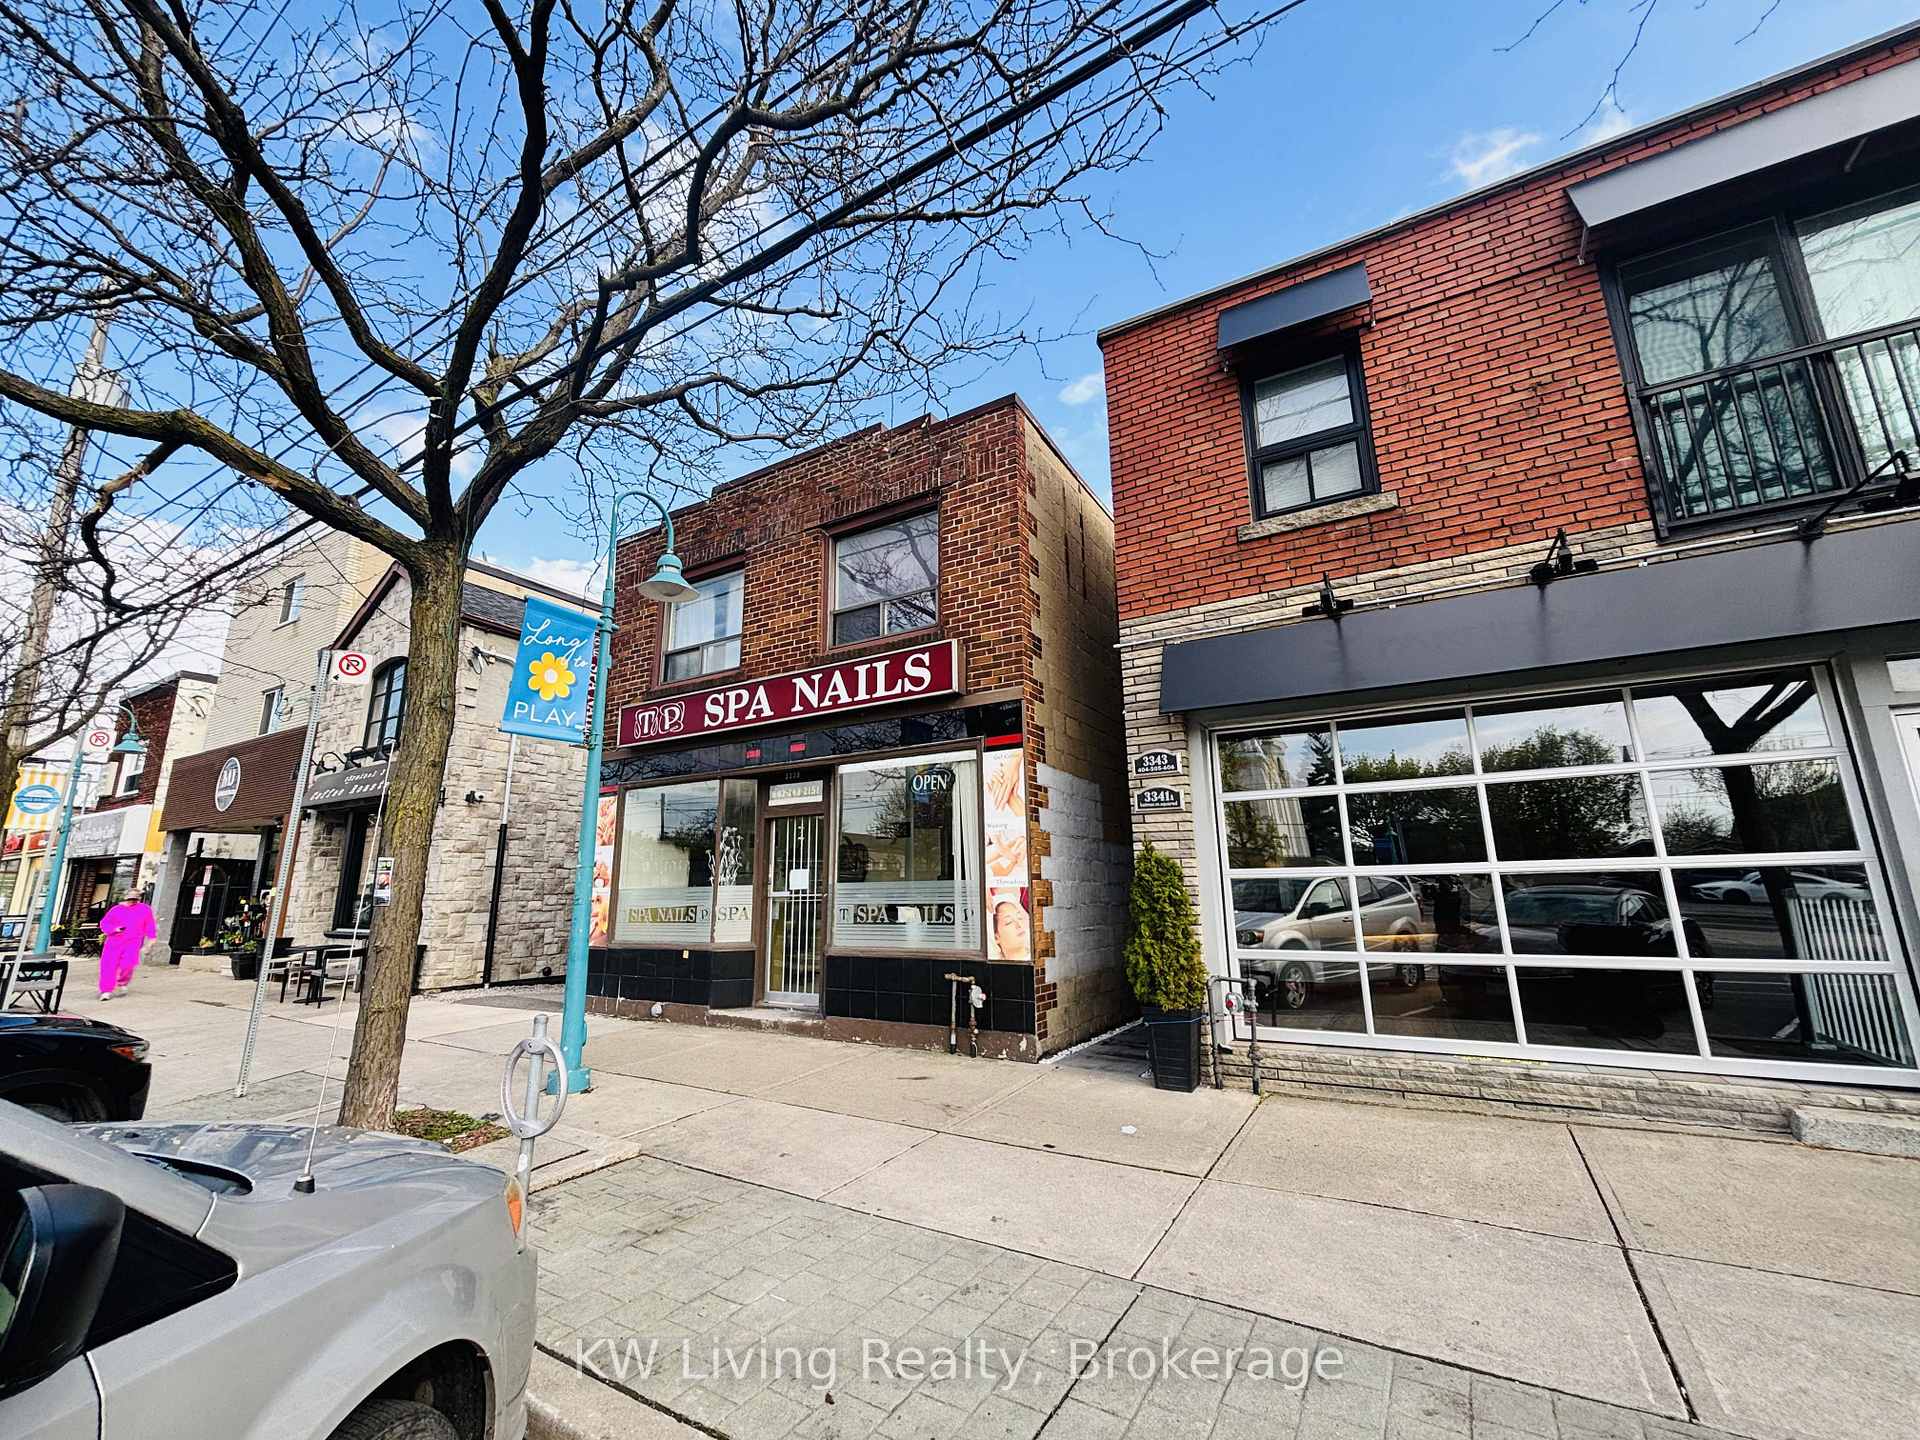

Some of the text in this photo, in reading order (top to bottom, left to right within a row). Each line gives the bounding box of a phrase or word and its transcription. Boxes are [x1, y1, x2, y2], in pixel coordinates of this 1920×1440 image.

[523, 618, 588, 666] Long
[573, 656, 588, 667] to
[703, 685, 774, 727] SPA
[791, 651, 931, 712] NAILS
[513, 701, 577, 726] PLAY
[1142, 754, 1168, 767] 3343
[912, 774, 948, 791] OPEN
[629, 907, 653, 923] SPA
[657, 906, 697, 923] NAILS
[717, 905, 750, 921] SPA
[856, 905, 890, 923] SPA
